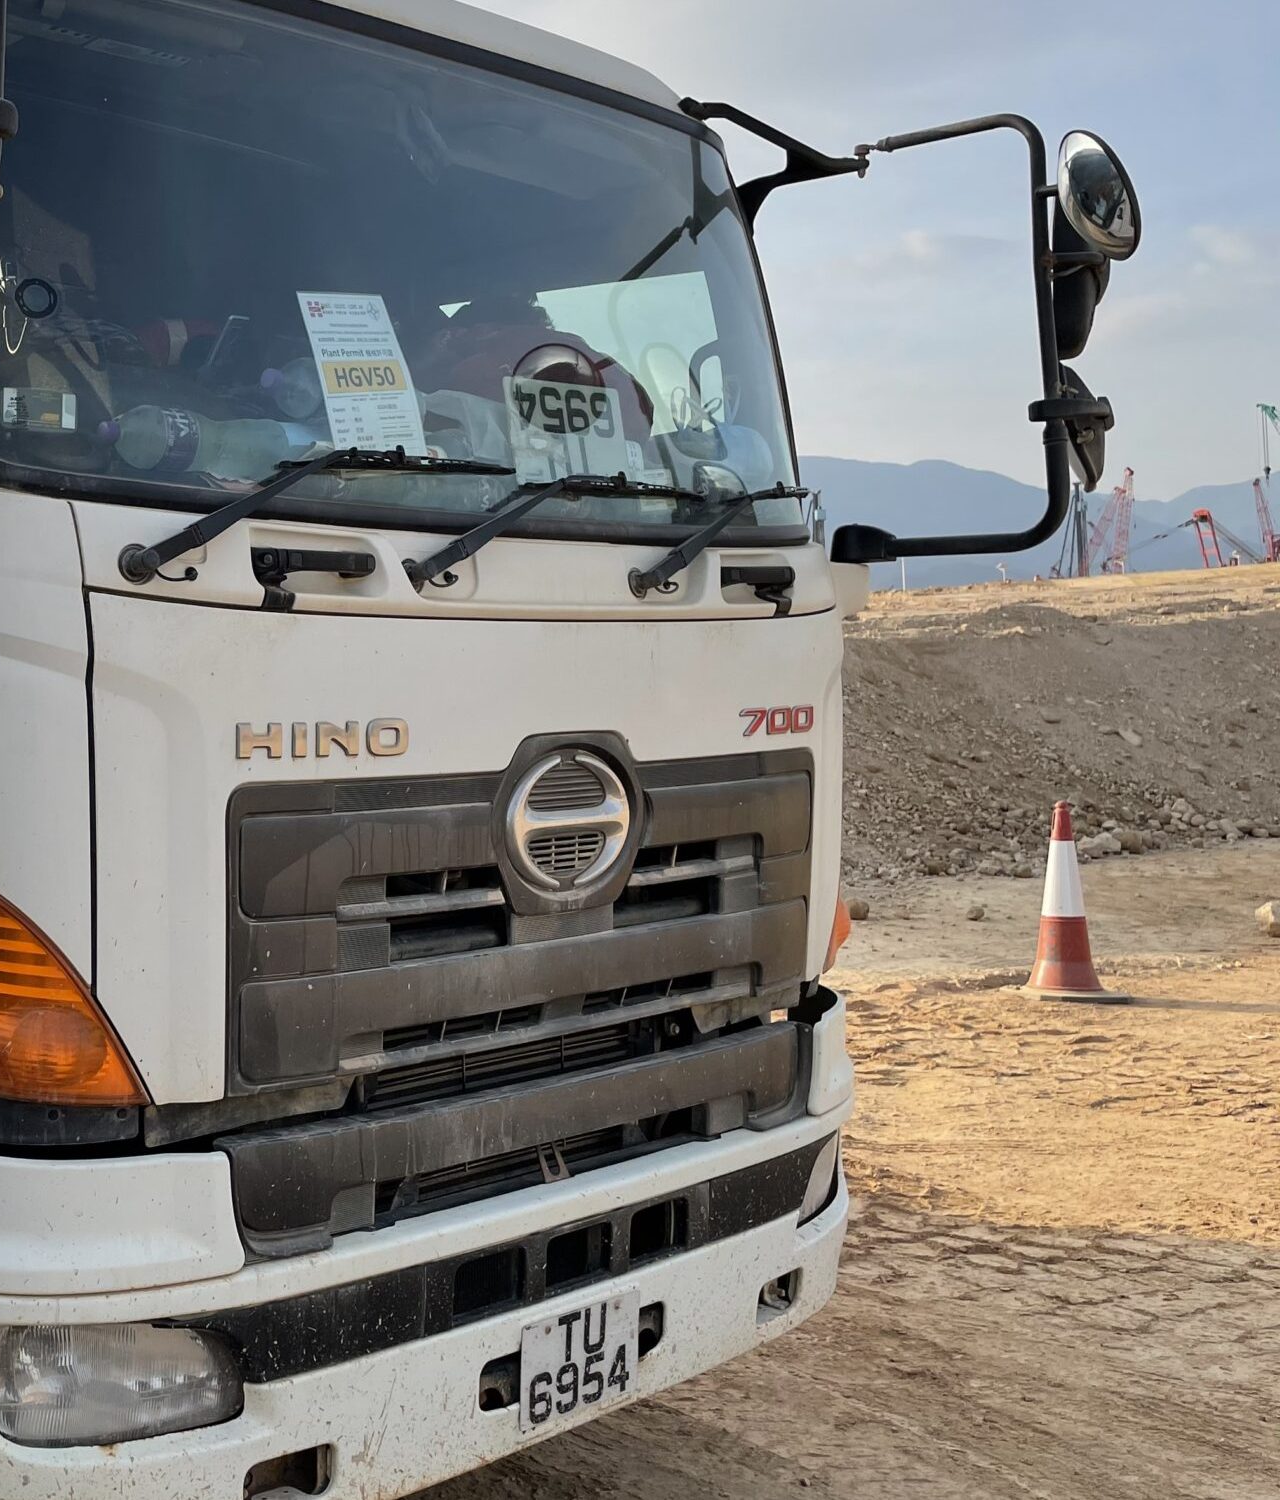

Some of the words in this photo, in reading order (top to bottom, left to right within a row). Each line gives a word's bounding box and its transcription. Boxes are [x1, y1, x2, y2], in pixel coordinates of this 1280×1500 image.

[321, 348, 340, 357] Plant
[342, 348, 365, 357] Permit
[334, 366, 396, 389] HGV50
[235, 717, 410, 760] HINO
[738, 704, 814, 737] 700
[558, 1302, 608, 1363] TU
[529, 1343, 630, 1425] 6954
